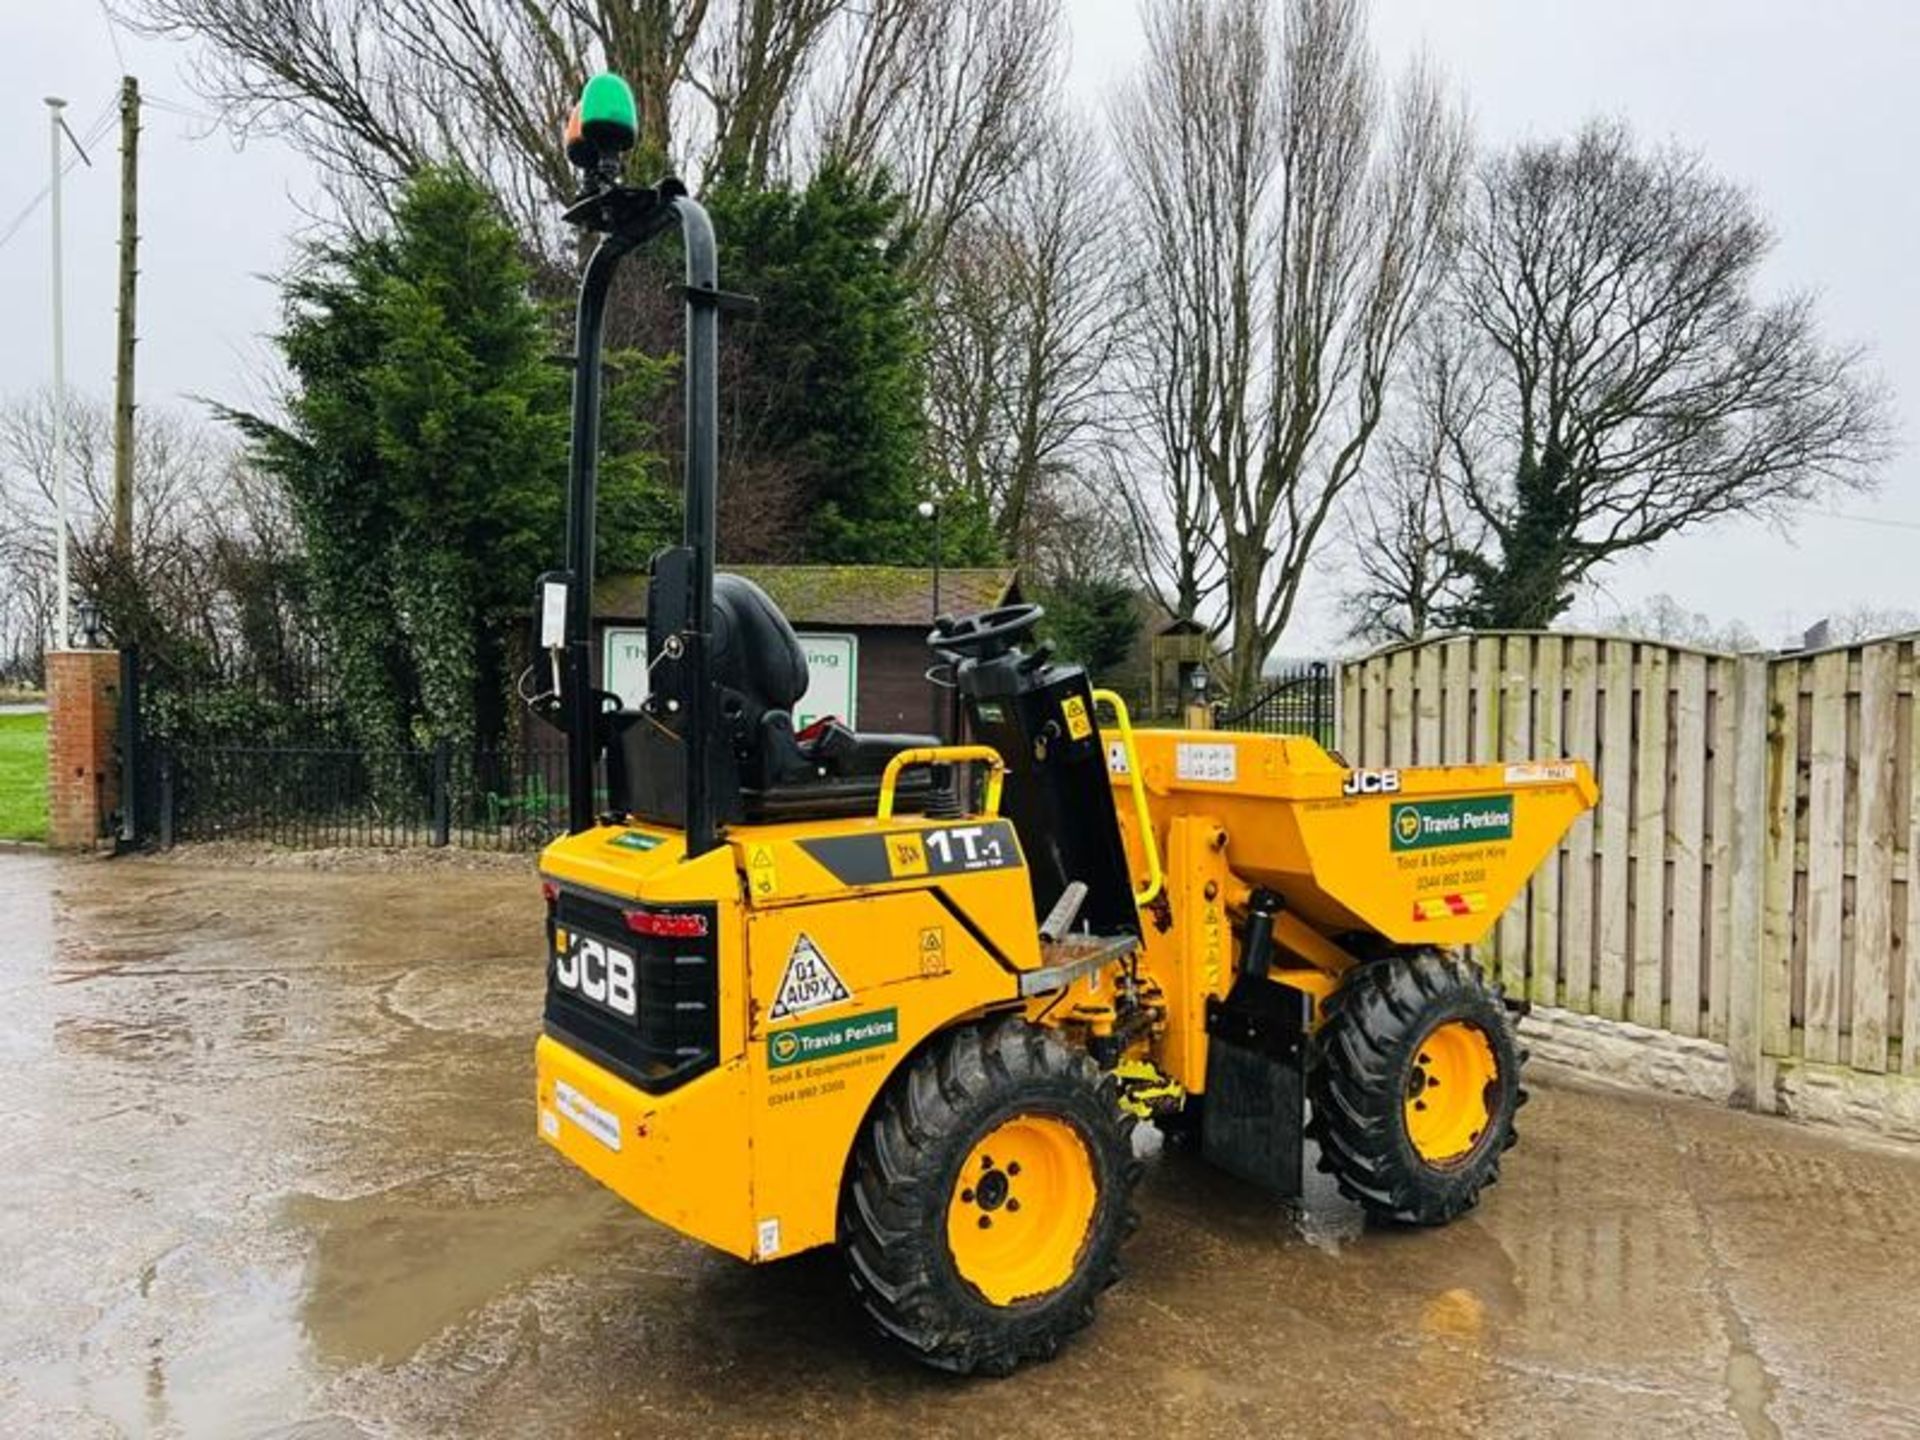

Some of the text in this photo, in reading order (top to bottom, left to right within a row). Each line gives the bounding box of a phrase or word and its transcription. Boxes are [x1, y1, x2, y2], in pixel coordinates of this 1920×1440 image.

[625, 645, 839, 668] Th ing
[1343, 769, 1400, 794] JCB
[1422, 814, 1459, 833] Travis
[1463, 810, 1509, 829] Perkins
[556, 927, 636, 1015] JCB
[801, 1032, 842, 1051] Travis
[845, 1021, 894, 1042] Perkins
[769, 1070, 792, 1085] Tool
